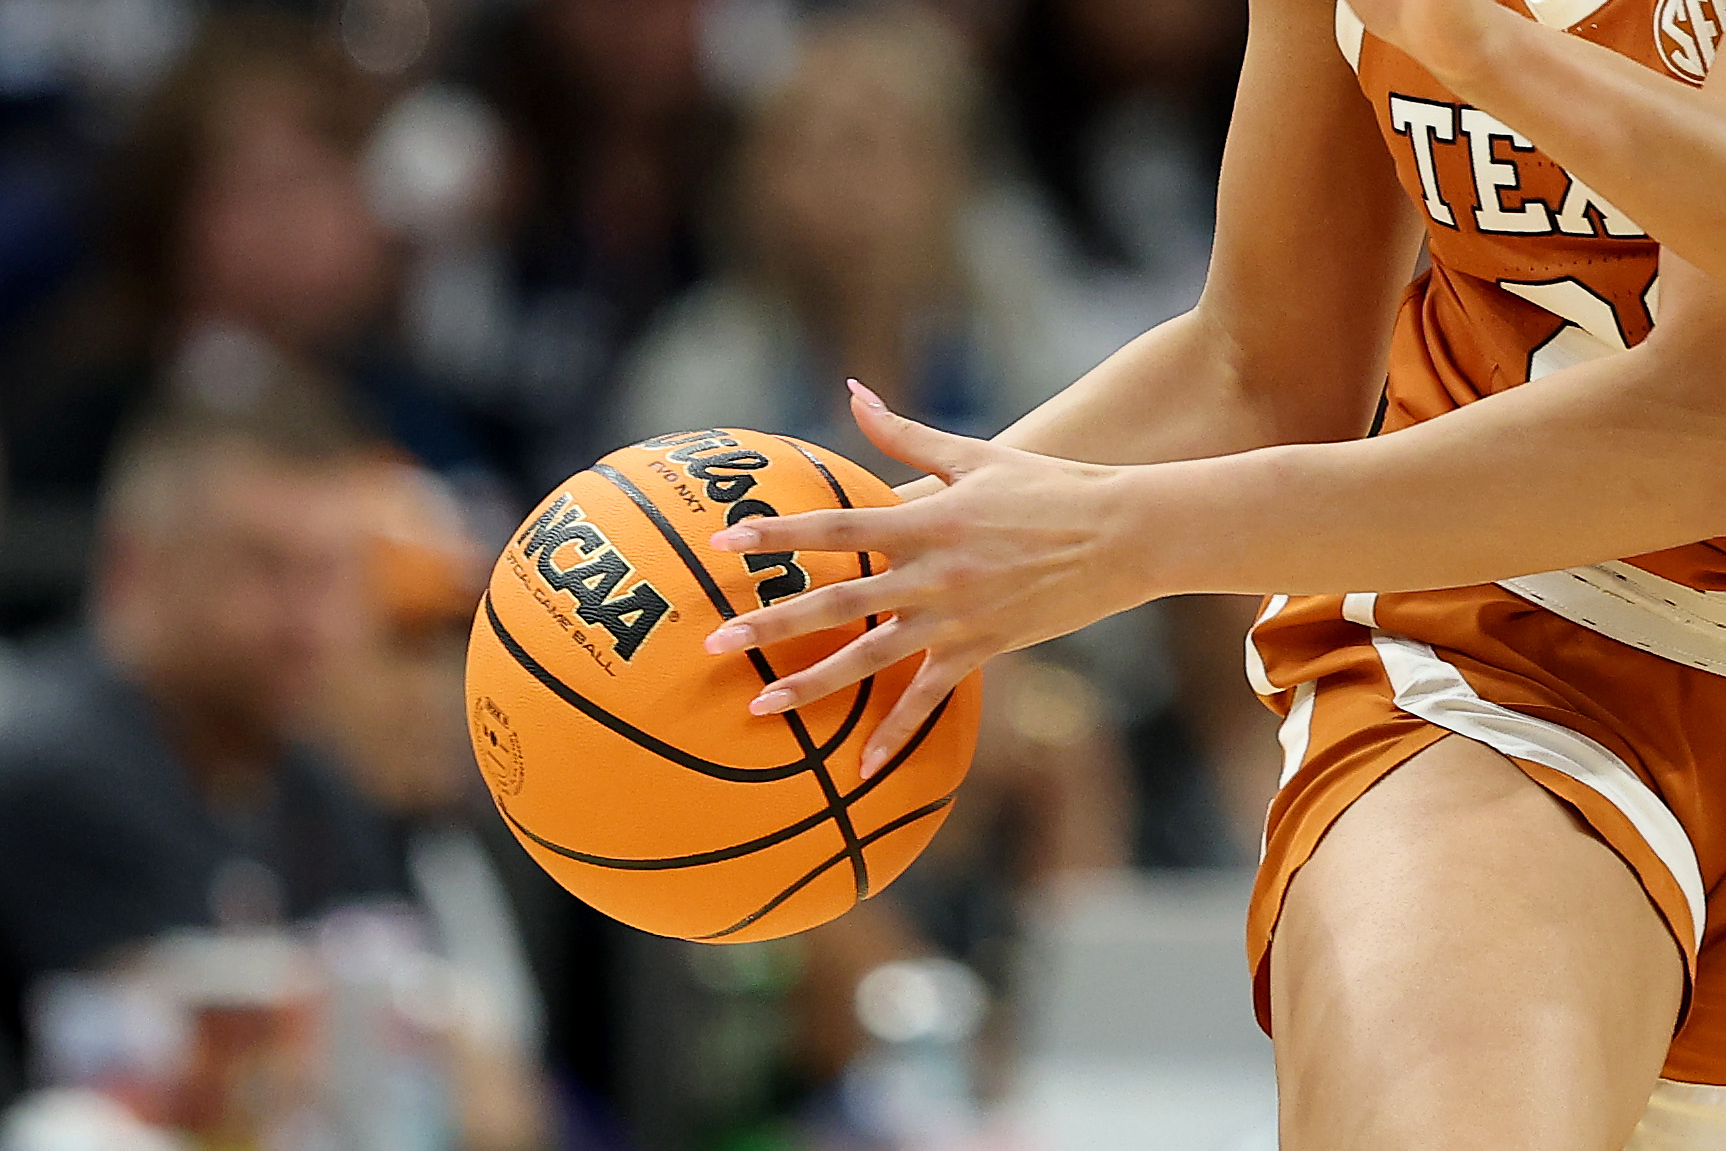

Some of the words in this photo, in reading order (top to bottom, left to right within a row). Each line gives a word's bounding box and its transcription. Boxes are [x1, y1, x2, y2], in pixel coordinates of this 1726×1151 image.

[674, 484, 706, 513] NXT
[514, 492, 674, 665] NCAA
[533, 588, 574, 631] GAME
[572, 630, 617, 677] BALL
